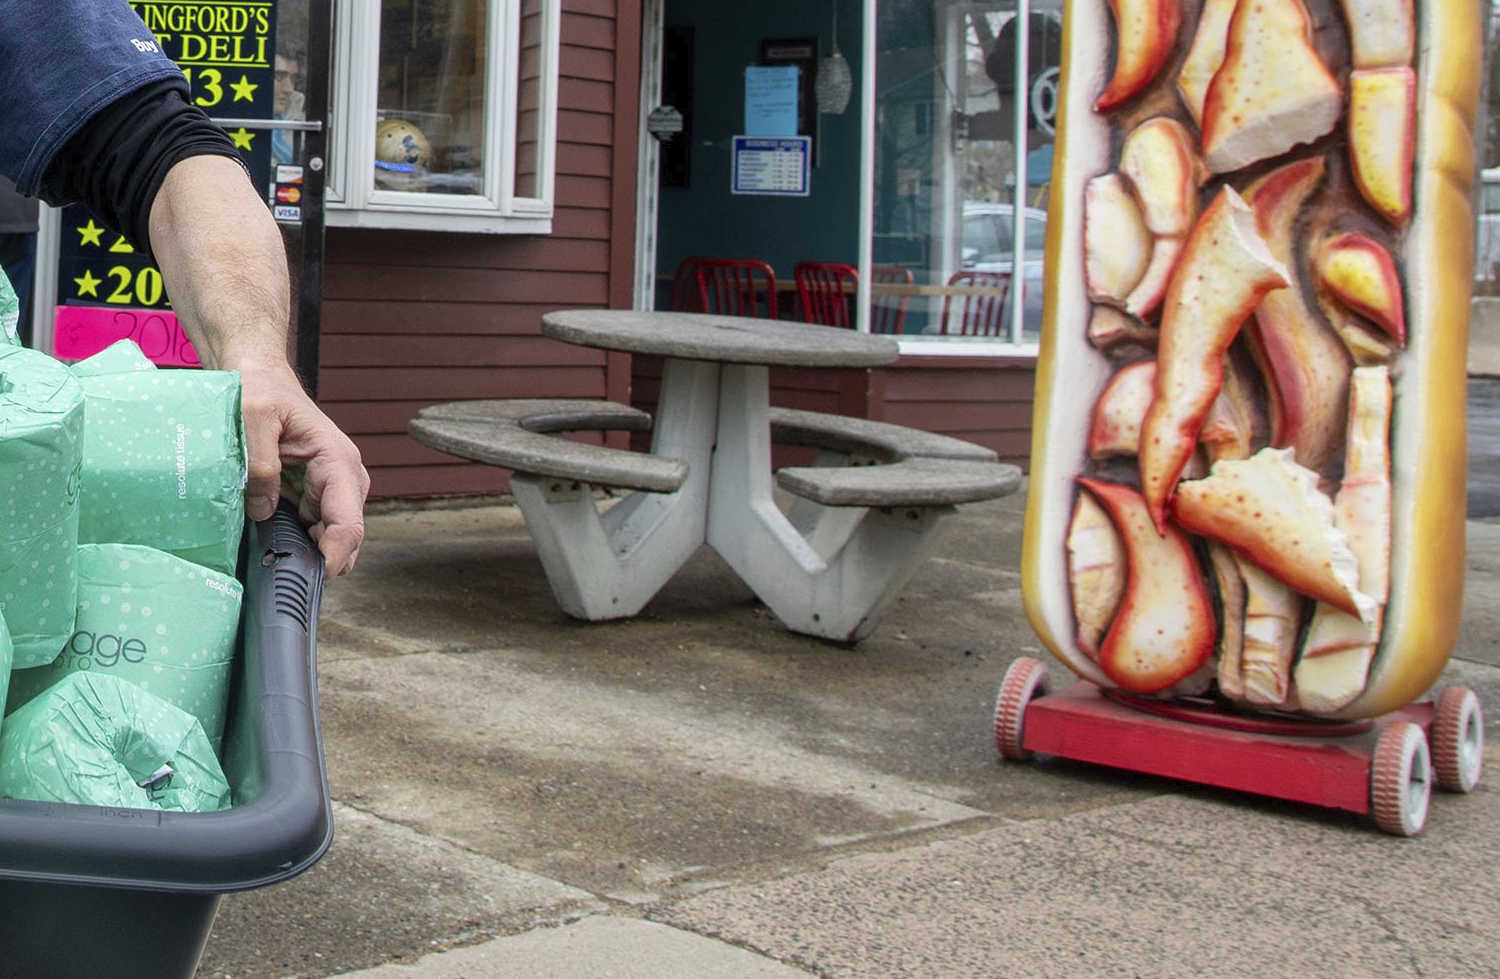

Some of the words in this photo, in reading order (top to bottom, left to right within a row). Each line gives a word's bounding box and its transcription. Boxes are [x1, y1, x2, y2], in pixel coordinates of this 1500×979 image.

[132, 4, 269, 35] INGFORD'S
[179, 34, 268, 63] DELI
[277, 208, 299, 218] VISA
[106, 265, 171, 306] 20
[174, 423, 185, 453] tissue
[174, 454, 187, 500] resolute
[204, 576, 238, 599] resolute
